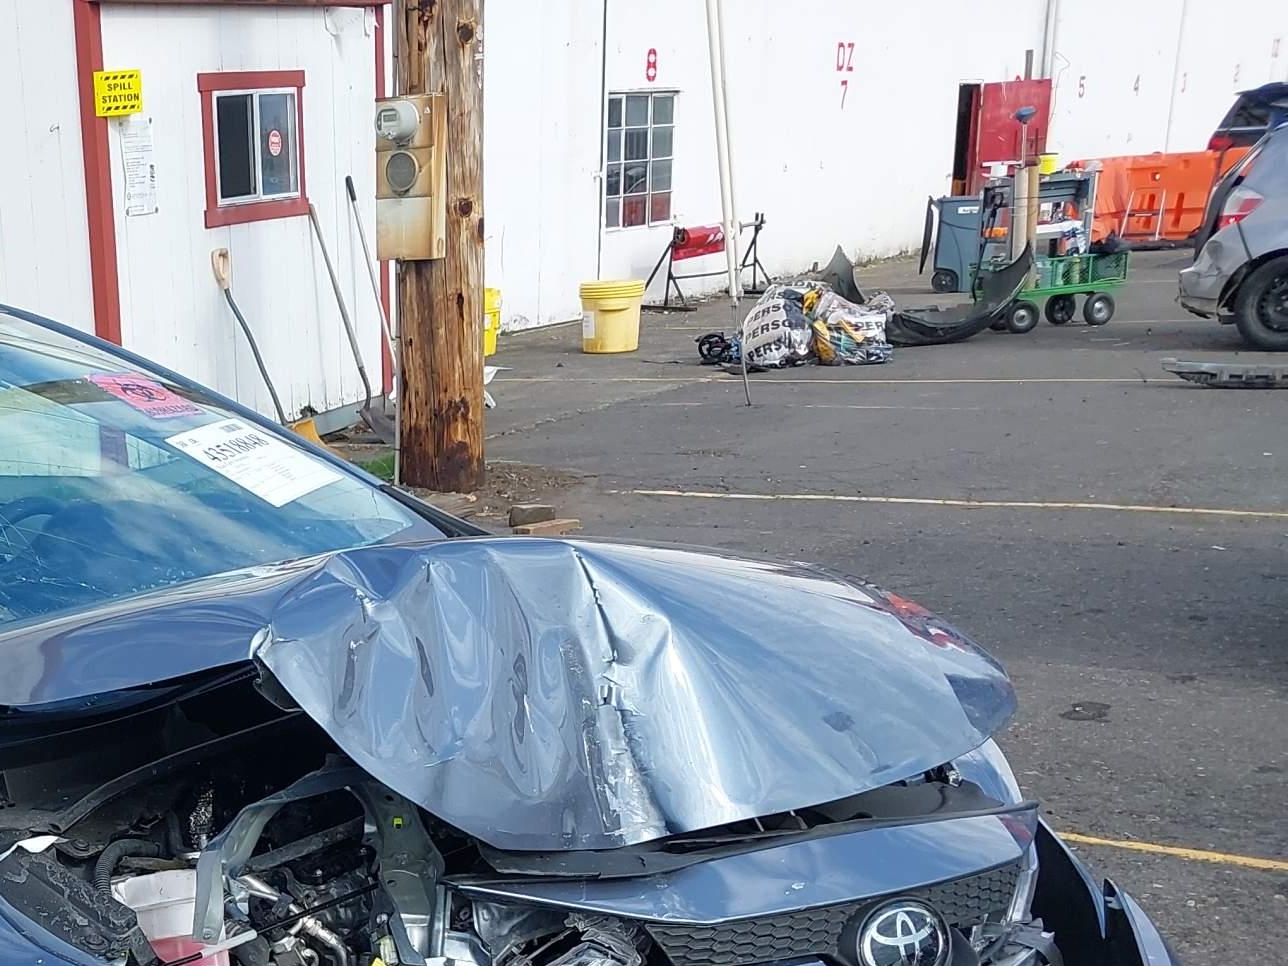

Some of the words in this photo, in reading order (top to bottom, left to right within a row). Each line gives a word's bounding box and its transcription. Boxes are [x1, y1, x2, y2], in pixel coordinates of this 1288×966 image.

[646, 48, 657, 82] 8
[107, 82, 133, 92] SPILL
[1078, 76, 1086, 98] 5
[1133, 74, 1140, 96] 4
[101, 93, 140, 104] STATION
[203, 433, 269, 462] 43518848
